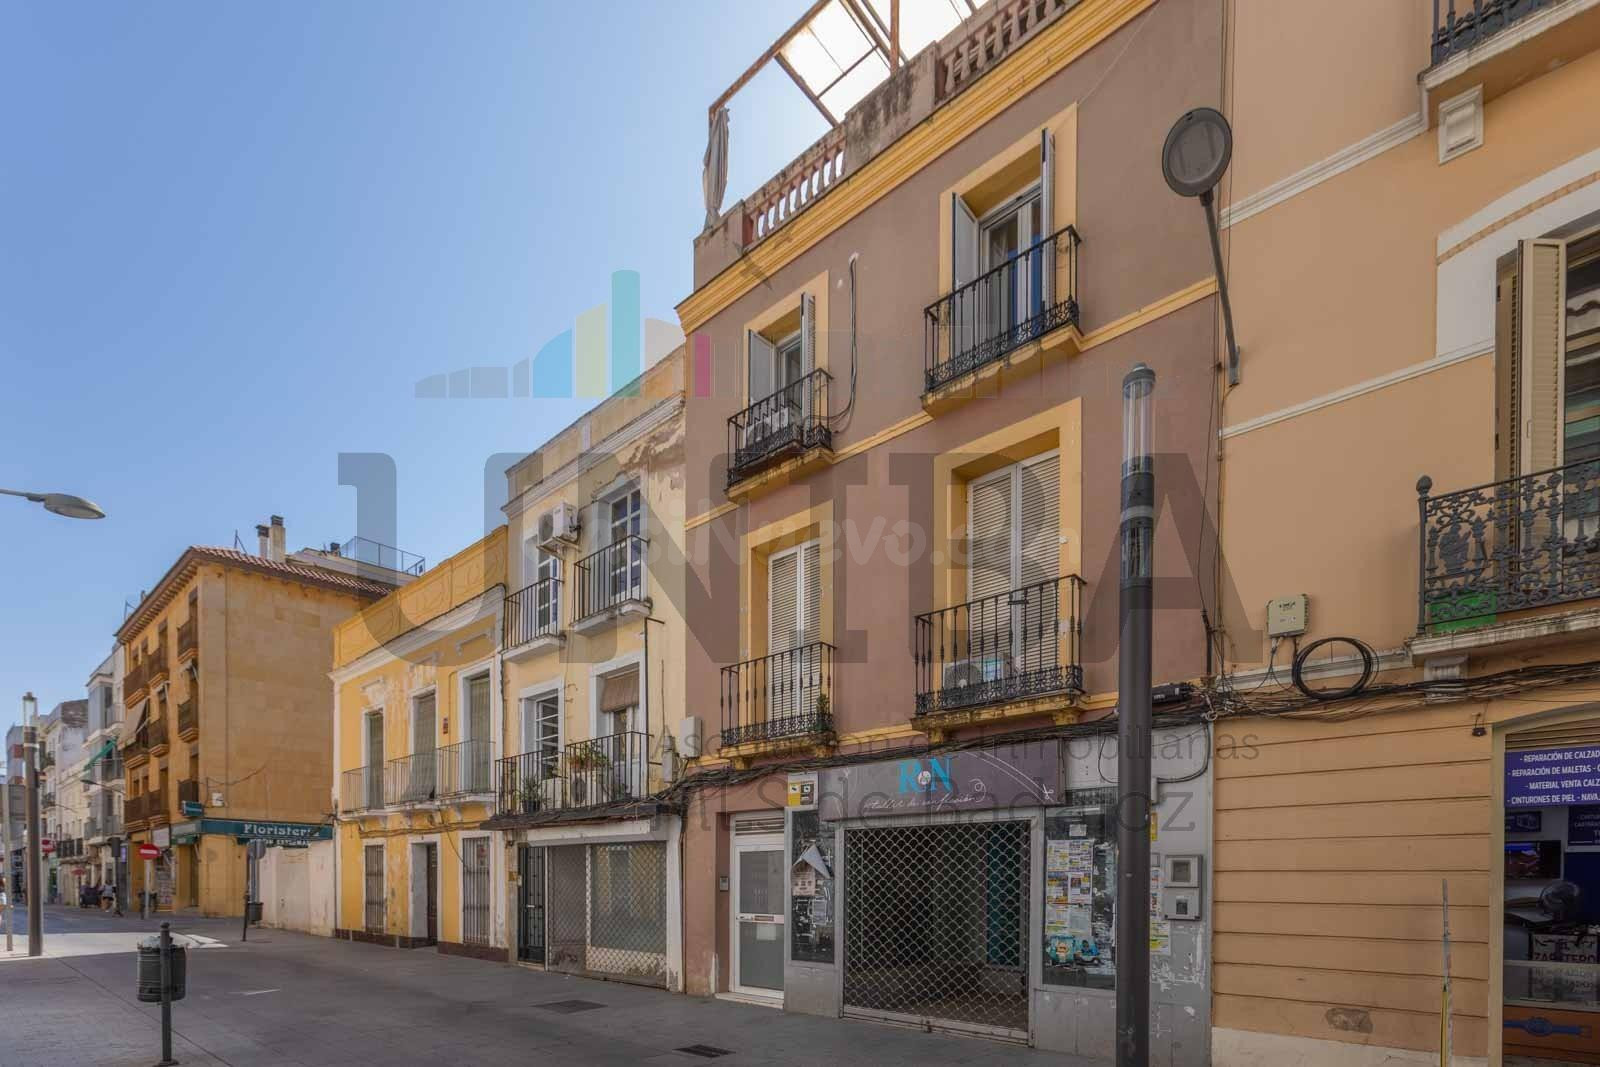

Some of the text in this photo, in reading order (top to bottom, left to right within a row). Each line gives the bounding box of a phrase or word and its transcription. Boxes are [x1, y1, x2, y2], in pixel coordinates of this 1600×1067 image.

[1523, 753, 1563, 762] REPARACIÓN
[1564, 752, 1573, 760] DE
[1512, 765, 1592, 777] REPARACIÓN DE MALETAS
[1528, 781, 1560, 790] MATERIAL
[1561, 779, 1581, 788] VENTA
[1511, 795, 1551, 804] CINTURONES
[1551, 794, 1561, 803] DE
[1562, 794, 1576, 802] PIEL
